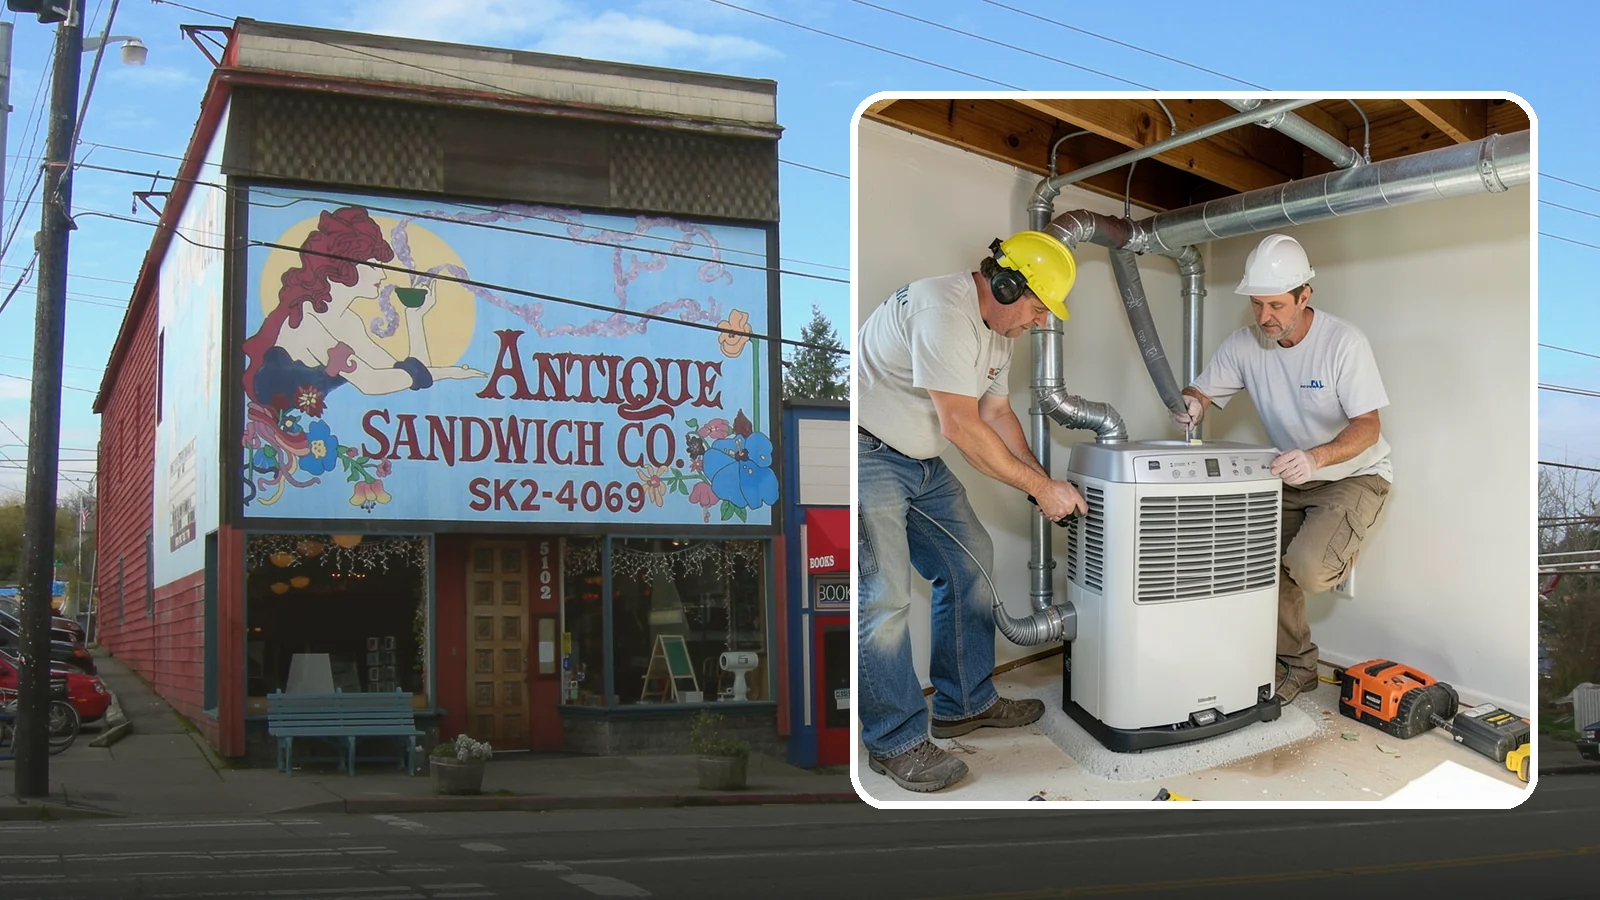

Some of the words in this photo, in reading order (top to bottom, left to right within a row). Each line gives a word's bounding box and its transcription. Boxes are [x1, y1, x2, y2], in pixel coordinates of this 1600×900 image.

[476, 329, 723, 420] ANTIQUE
[361, 408, 604, 467] SANDWICH
[617, 422, 685, 469] CO.
[468, 477, 645, 513] SK2-4069
[540, 541, 551, 600] 5102
[809, 554, 835, 569] BOOKS
